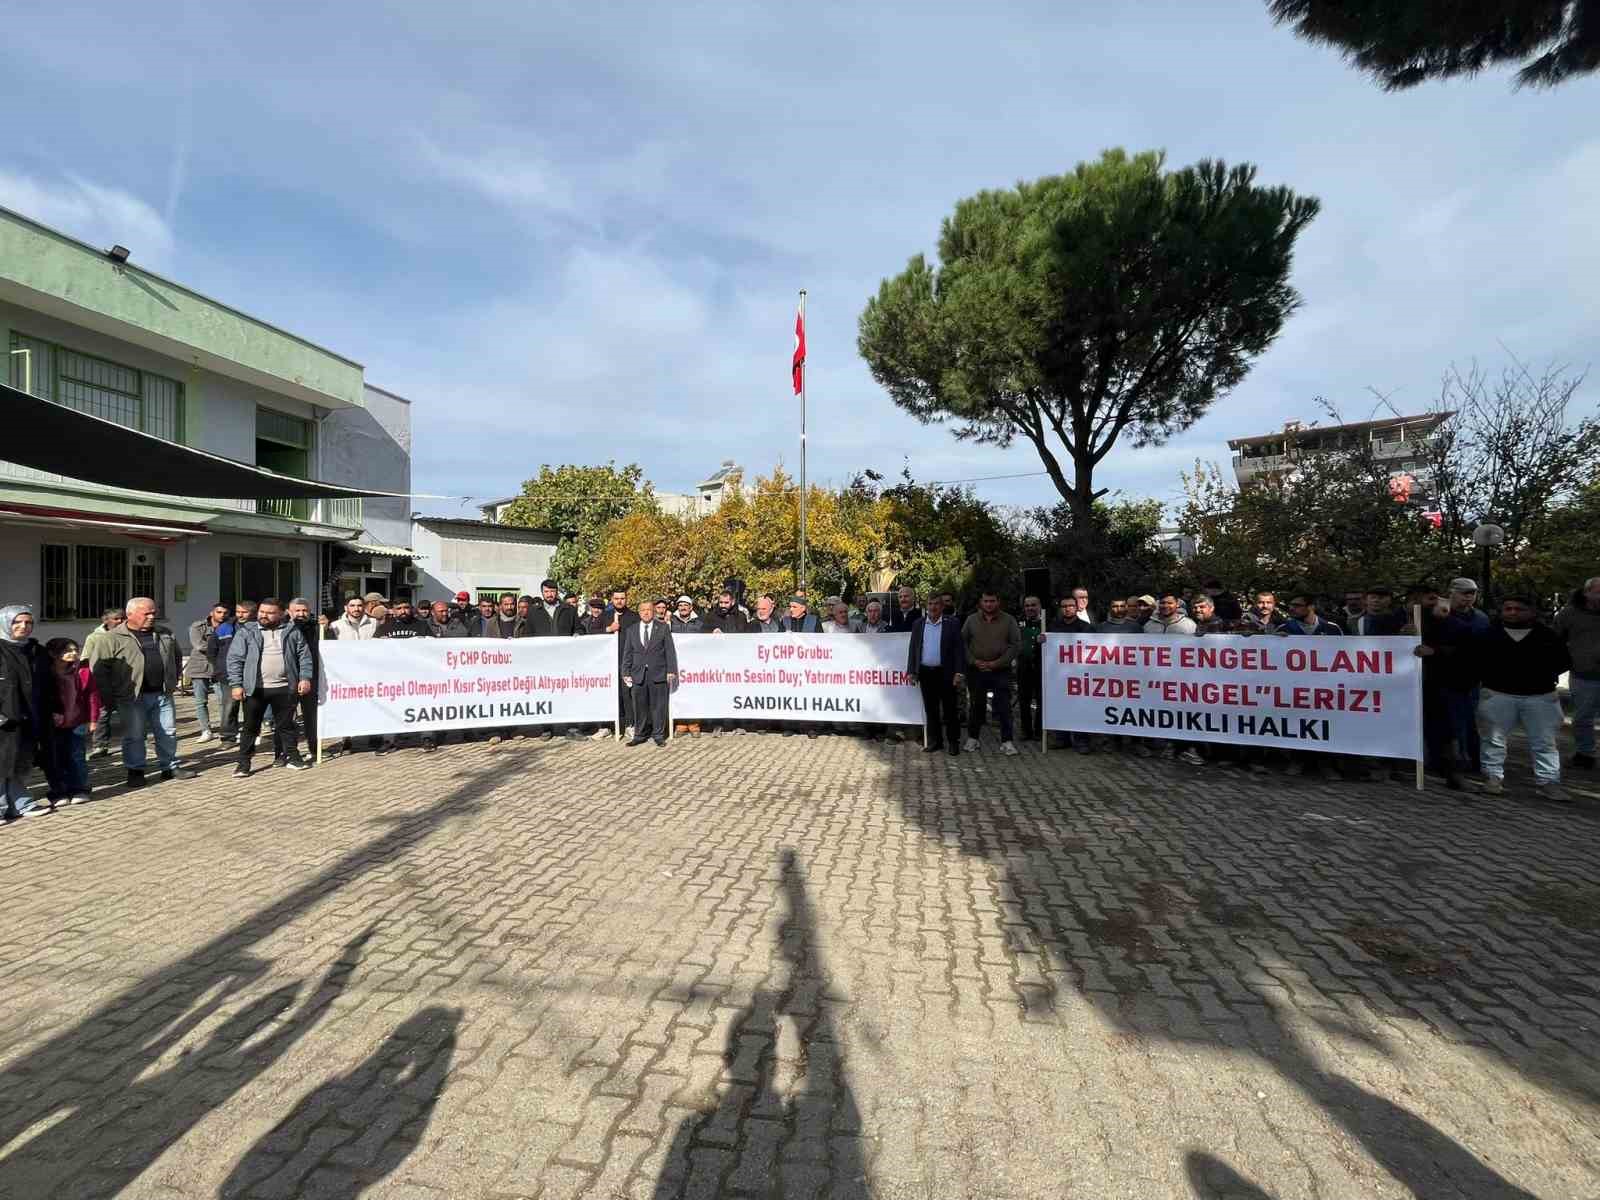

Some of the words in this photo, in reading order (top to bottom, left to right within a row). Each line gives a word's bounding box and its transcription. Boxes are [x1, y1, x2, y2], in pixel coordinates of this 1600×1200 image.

[446, 651, 458, 669] Ey
[460, 651, 479, 665] CHP
[481, 650, 512, 665] Grubu:
[758, 645, 770, 663] Ey
[773, 645, 794, 659] CHP
[797, 645, 833, 660] Grubu:
[1059, 640, 1172, 667] HİZMETE
[1180, 647, 1277, 670] ENGEL
[1286, 649, 1393, 674] OLANI
[331, 683, 374, 700] Hizmete
[377, 681, 406, 701] Engel
[408, 679, 450, 698] Olmayın!
[454, 678, 476, 694] Kısır
[477, 677, 511, 696] Siyaset
[513, 675, 536, 694] Değil
[539, 675, 569, 693] Altyapı
[571, 671, 611, 692] İstiyoruz!
[744, 669, 776, 683] Sesini
[804, 670, 846, 684] Yatırımı
[849, 670, 912, 686] ENGELLEM
[1067, 673, 1140, 699] BİZDE
[404, 704, 494, 723] SANDIKLI
[500, 701, 552, 717] HALKI
[733, 696, 807, 711] SANDIKLI
[812, 697, 860, 712] HALKI
[1104, 706, 1228, 733] SANDIKLI
[1238, 715, 1329, 741] HALKI
